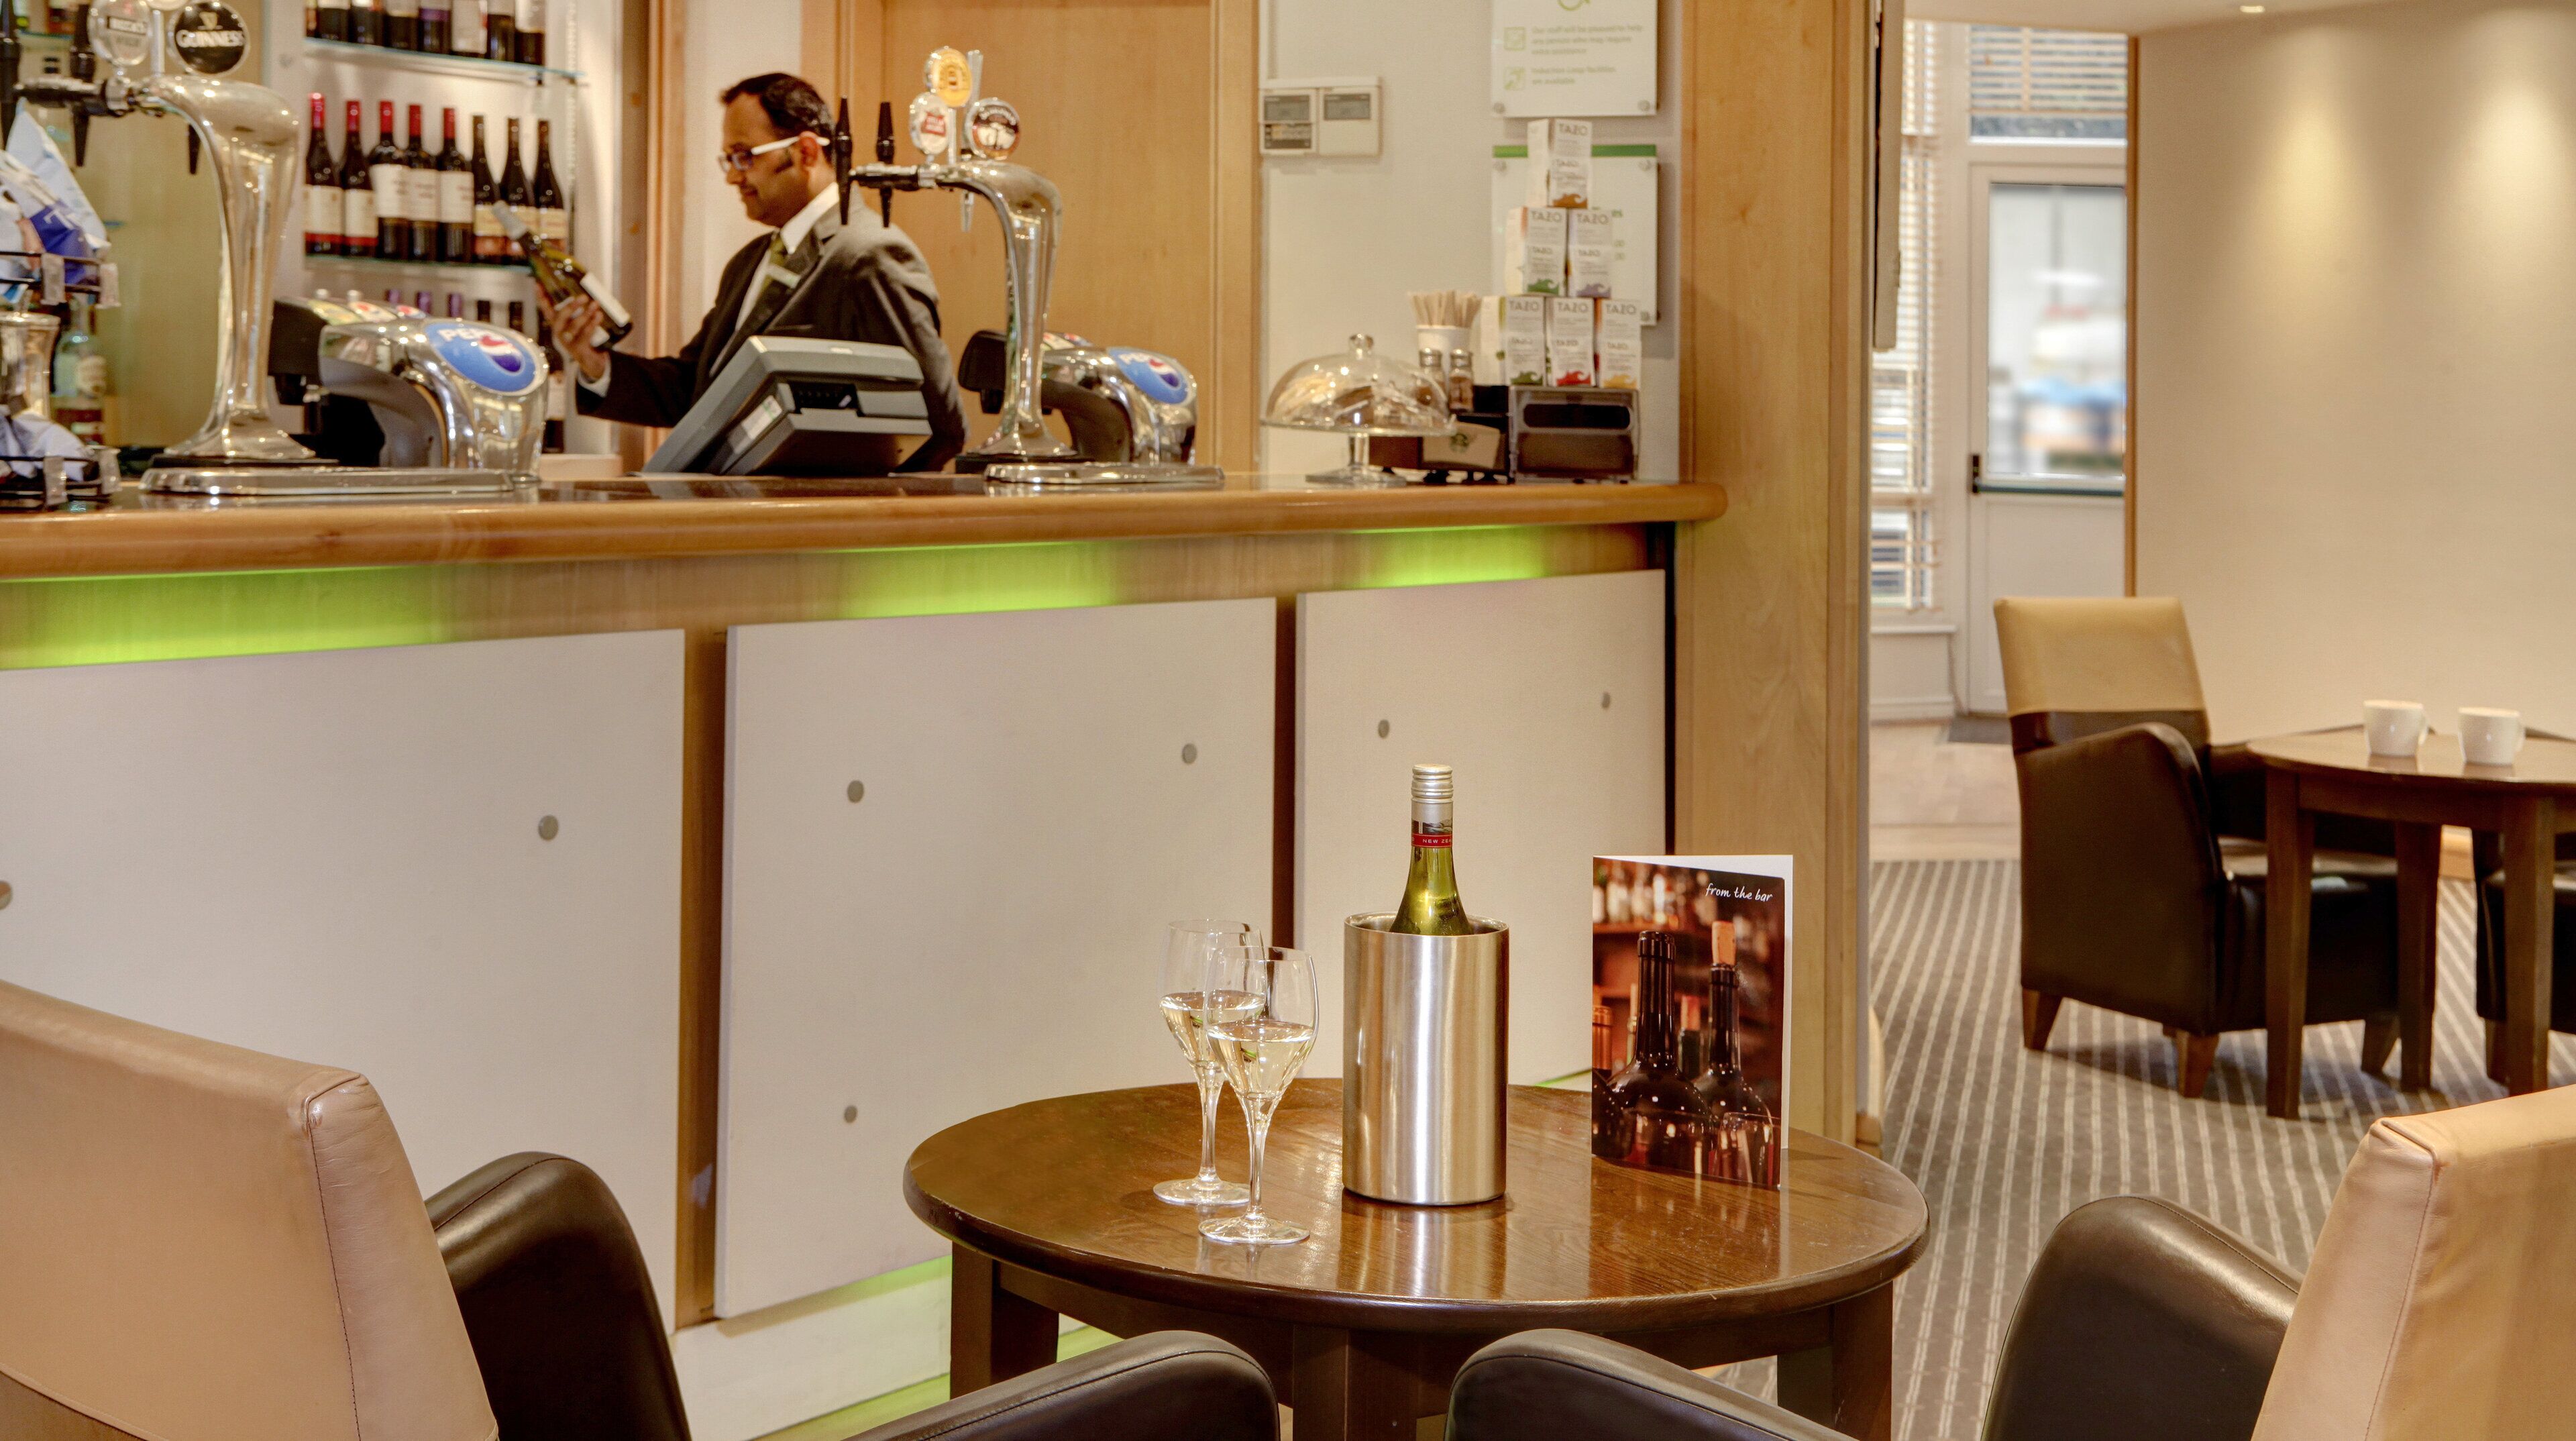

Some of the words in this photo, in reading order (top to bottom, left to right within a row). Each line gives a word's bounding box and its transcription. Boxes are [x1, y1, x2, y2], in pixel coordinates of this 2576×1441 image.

[176, 30, 245, 48] GUINNESS
[1559, 123, 1588, 136] TAZO
[1531, 211, 1562, 223] TAZO
[1577, 213, 1609, 225] TAZO
[1509, 302, 1540, 312] TAZO
[1558, 302, 1589, 313] TAZO
[1606, 304, 1637, 315] TAZO
[1705, 883, 1731, 898] from
[1734, 886, 1752, 900] the
[1755, 889, 1774, 902] bar
